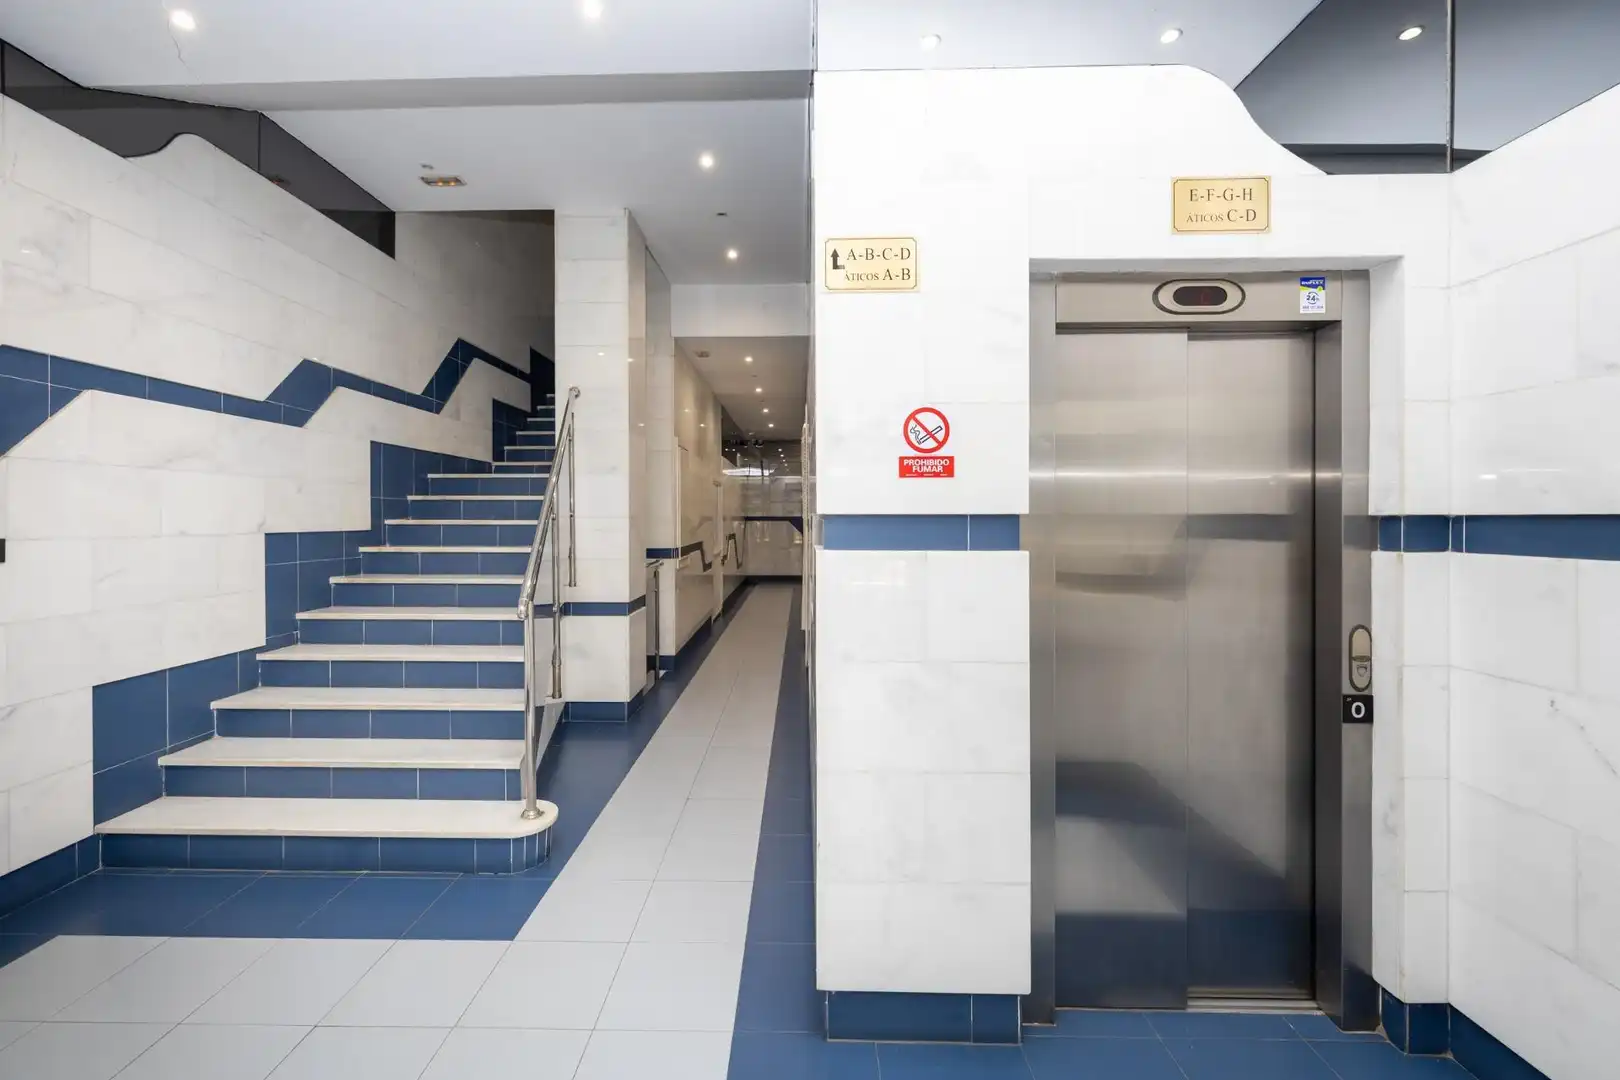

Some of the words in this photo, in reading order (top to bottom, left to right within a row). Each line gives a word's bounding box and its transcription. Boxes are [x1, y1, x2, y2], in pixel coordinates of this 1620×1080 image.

[1190, 188, 1253, 202] E-F-G-H
[1227, 208, 1257, 222] C-D
[846, 247, 911, 260] A-B-C-D
[883, 268, 911, 281] A-B
[903, 458, 950, 466] PROHIBIDO
[912, 465, 944, 473] FUMAR
